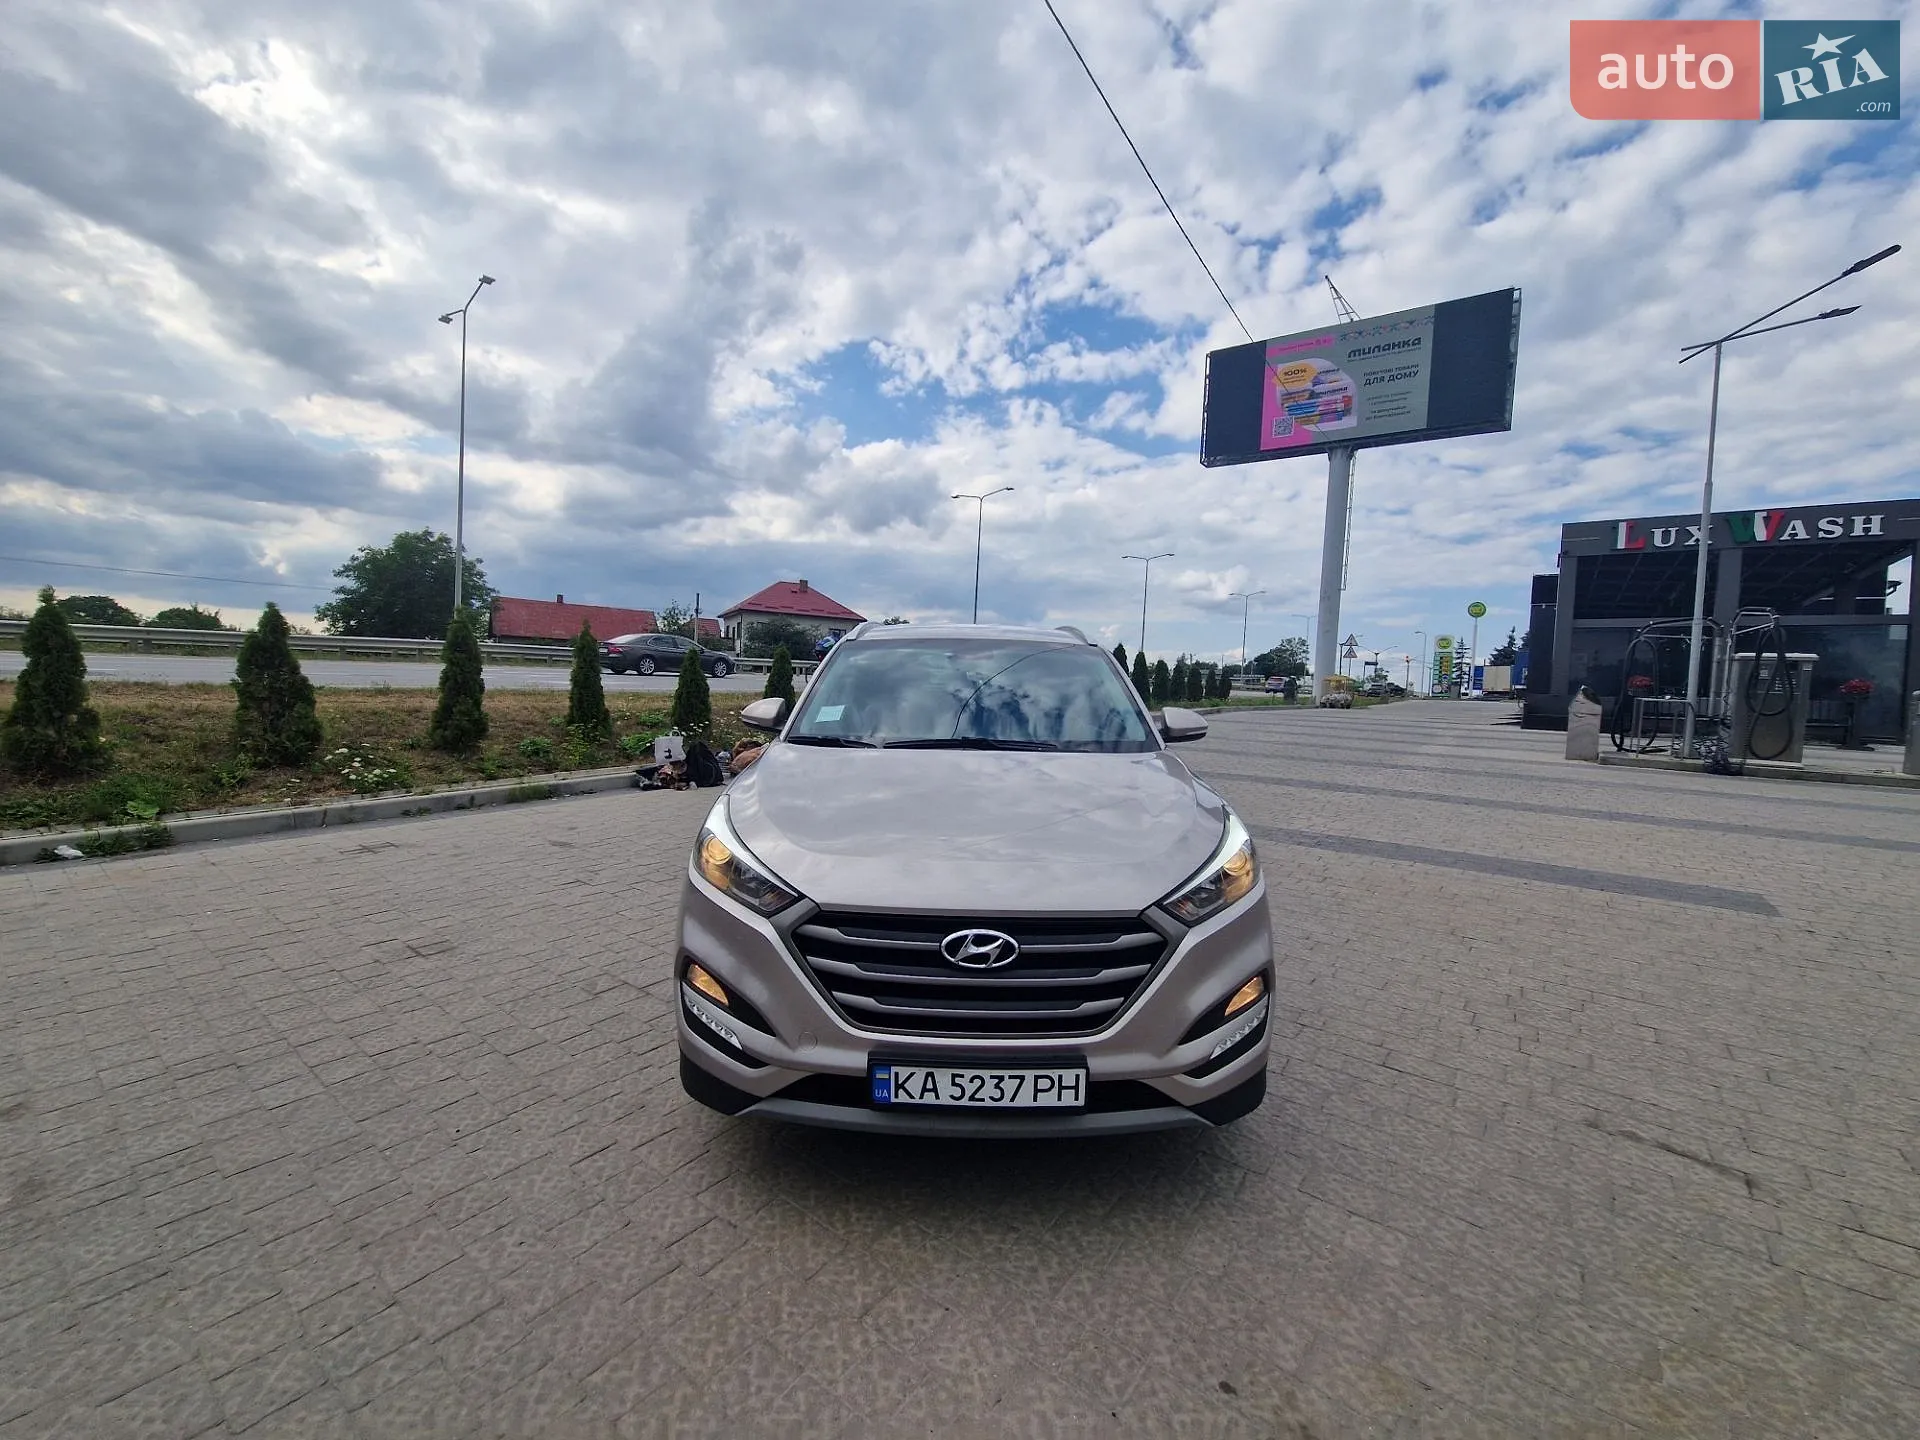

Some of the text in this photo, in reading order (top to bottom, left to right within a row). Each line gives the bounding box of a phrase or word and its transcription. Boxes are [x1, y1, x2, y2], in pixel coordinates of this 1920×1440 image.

[1363, 369, 1419, 387] ДЛЯ ДОМУ
[1724, 510, 1886, 545] WASH
[875, 1088, 889, 1098] UA
[894, 1071, 1080, 1103] KA 5237 PH
